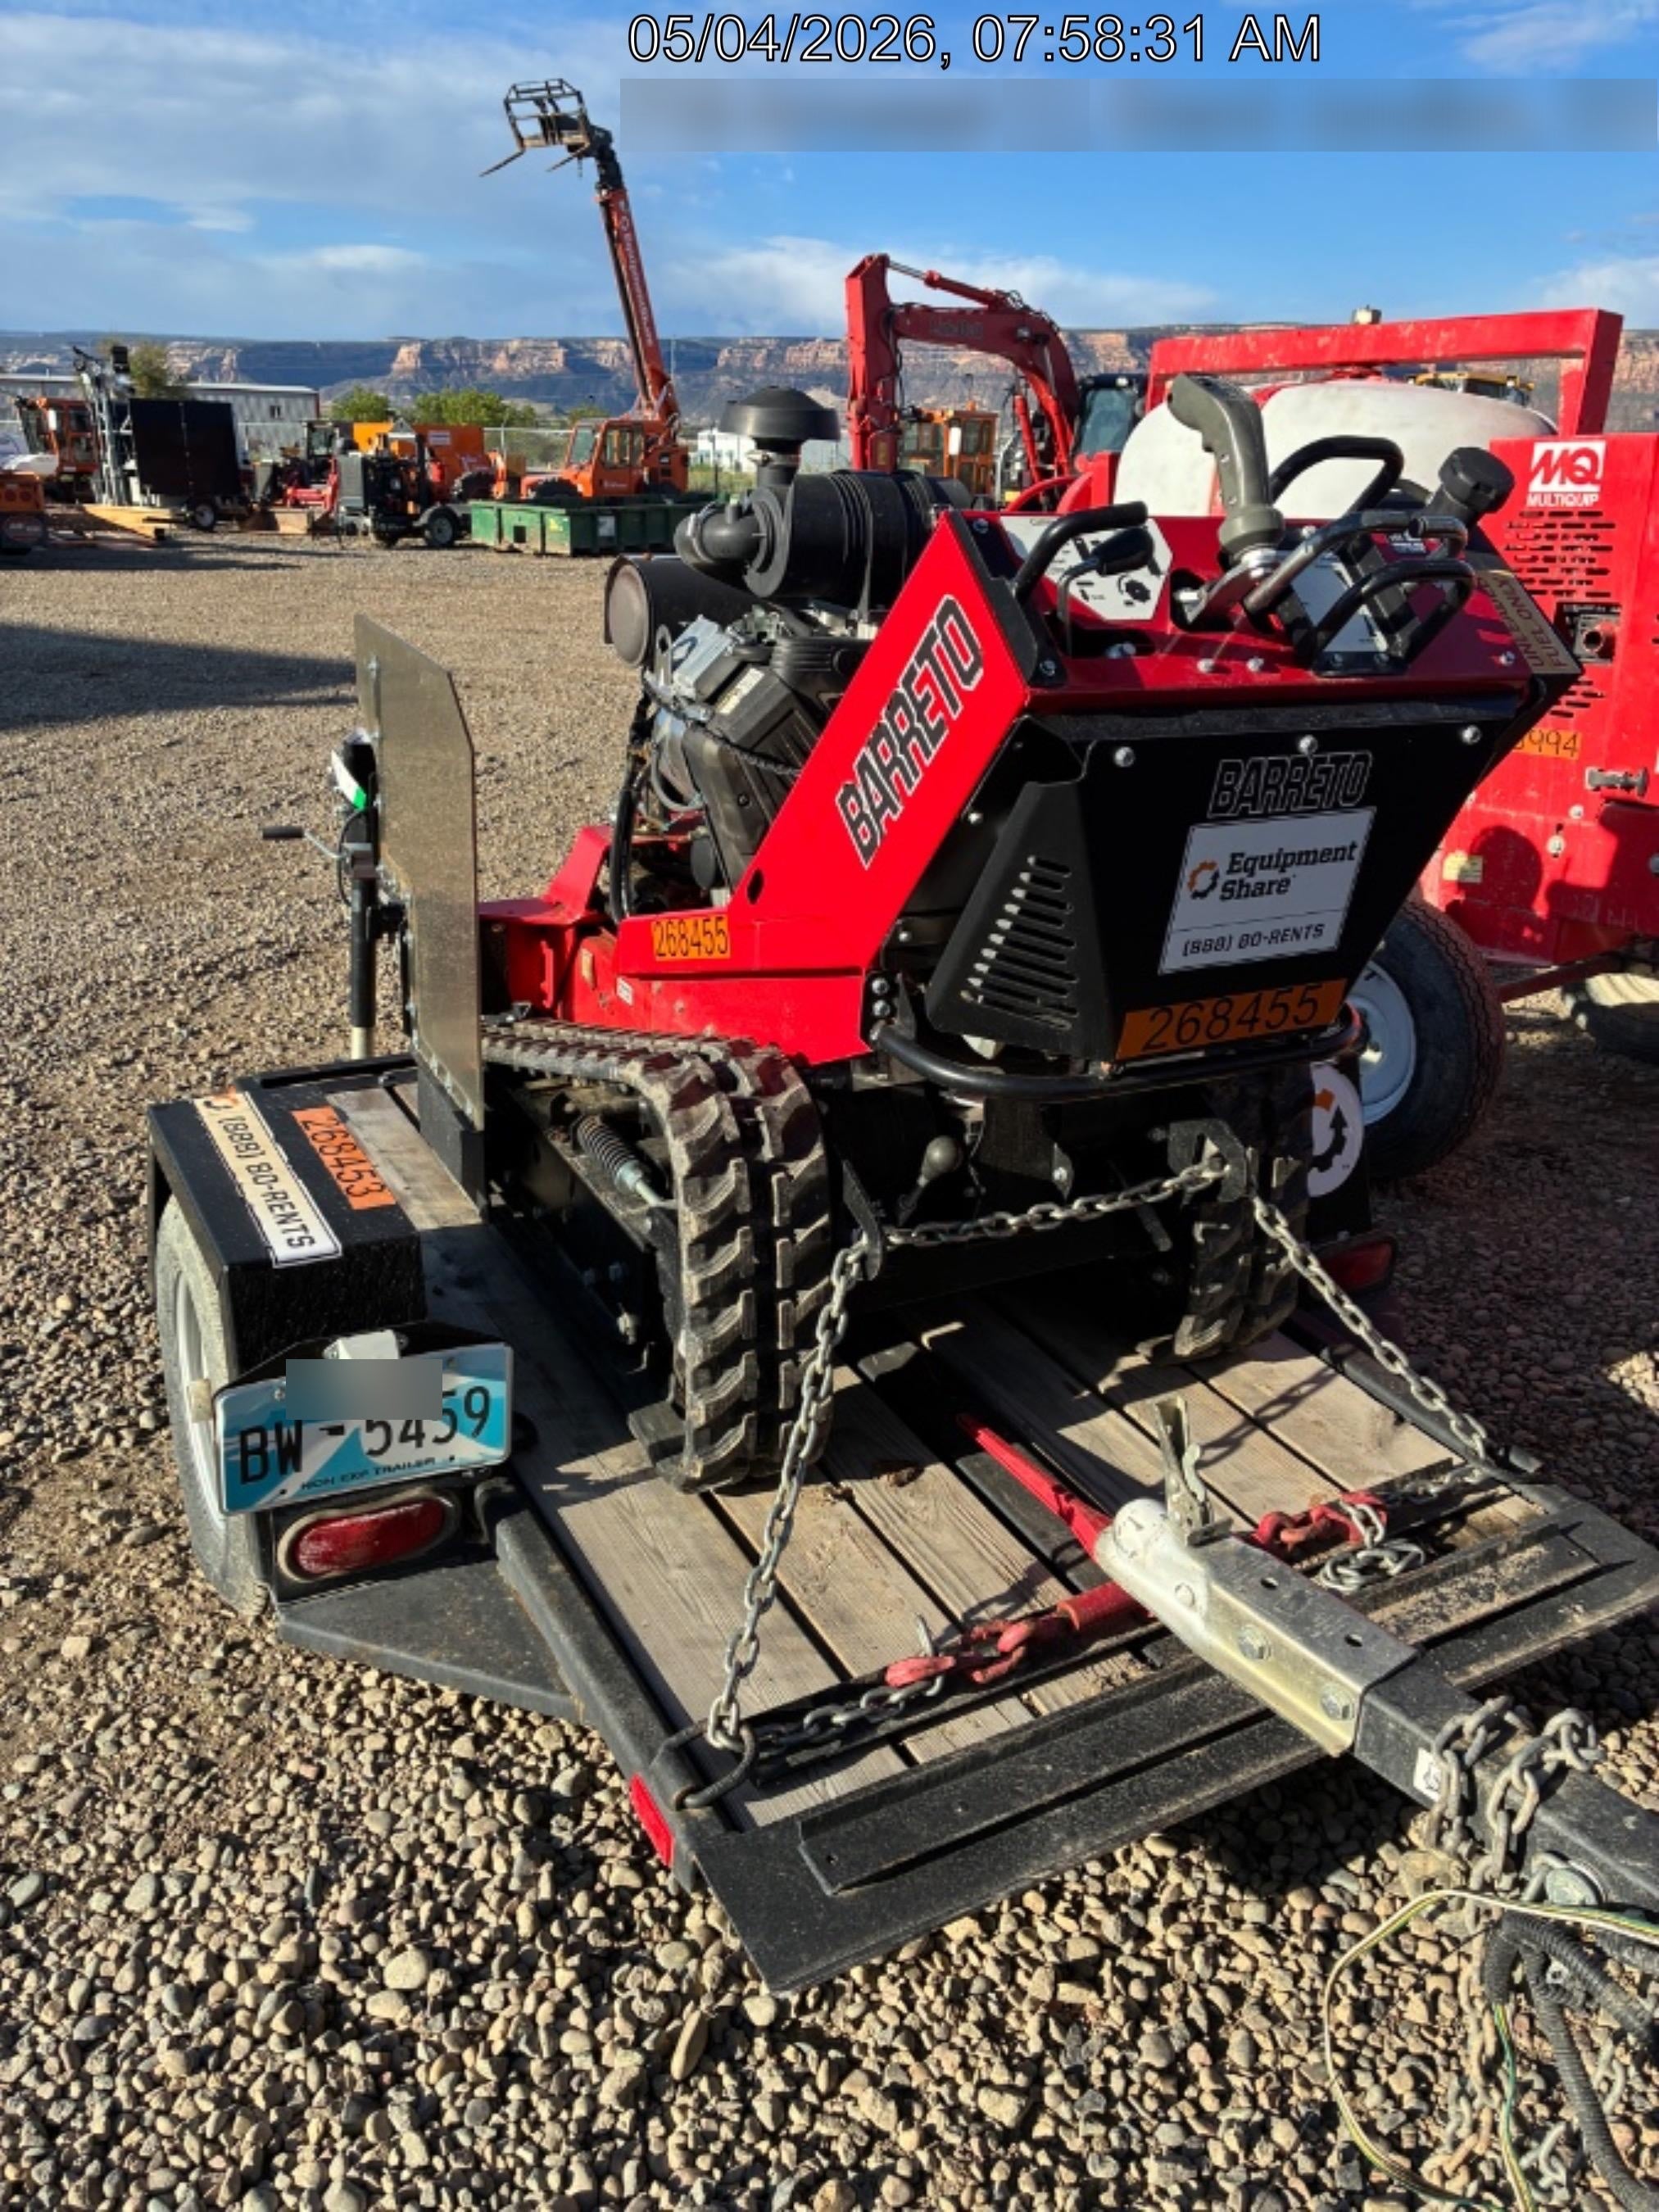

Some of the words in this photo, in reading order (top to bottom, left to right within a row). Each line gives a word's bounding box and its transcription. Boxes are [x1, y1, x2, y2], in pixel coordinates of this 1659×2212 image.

[1529, 446, 1602, 485] MQ
[1526, 493, 1598, 507] MULTIQUIP
[1498, 578, 1532, 620] ONLY
[1532, 626, 1566, 667] FUEL
[835, 594, 983, 871] BARRETO
[1207, 750, 1373, 818] BARRETO
[1226, 841, 1358, 878] Equipment
[1220, 875, 1291, 901] Share
[654, 916, 728, 957] 268455
[1182, 935, 1232, 957] (888)
[1238, 922, 1325, 949] 80-RENTS
[1142, 984, 1323, 1050] 268455
[301, 1117, 384, 1198] 268453
[217, 1117, 265, 1158] (888)
[246, 1163, 315, 1249] 80-RENTS
[373, 1457, 436, 1475] TRAILER
